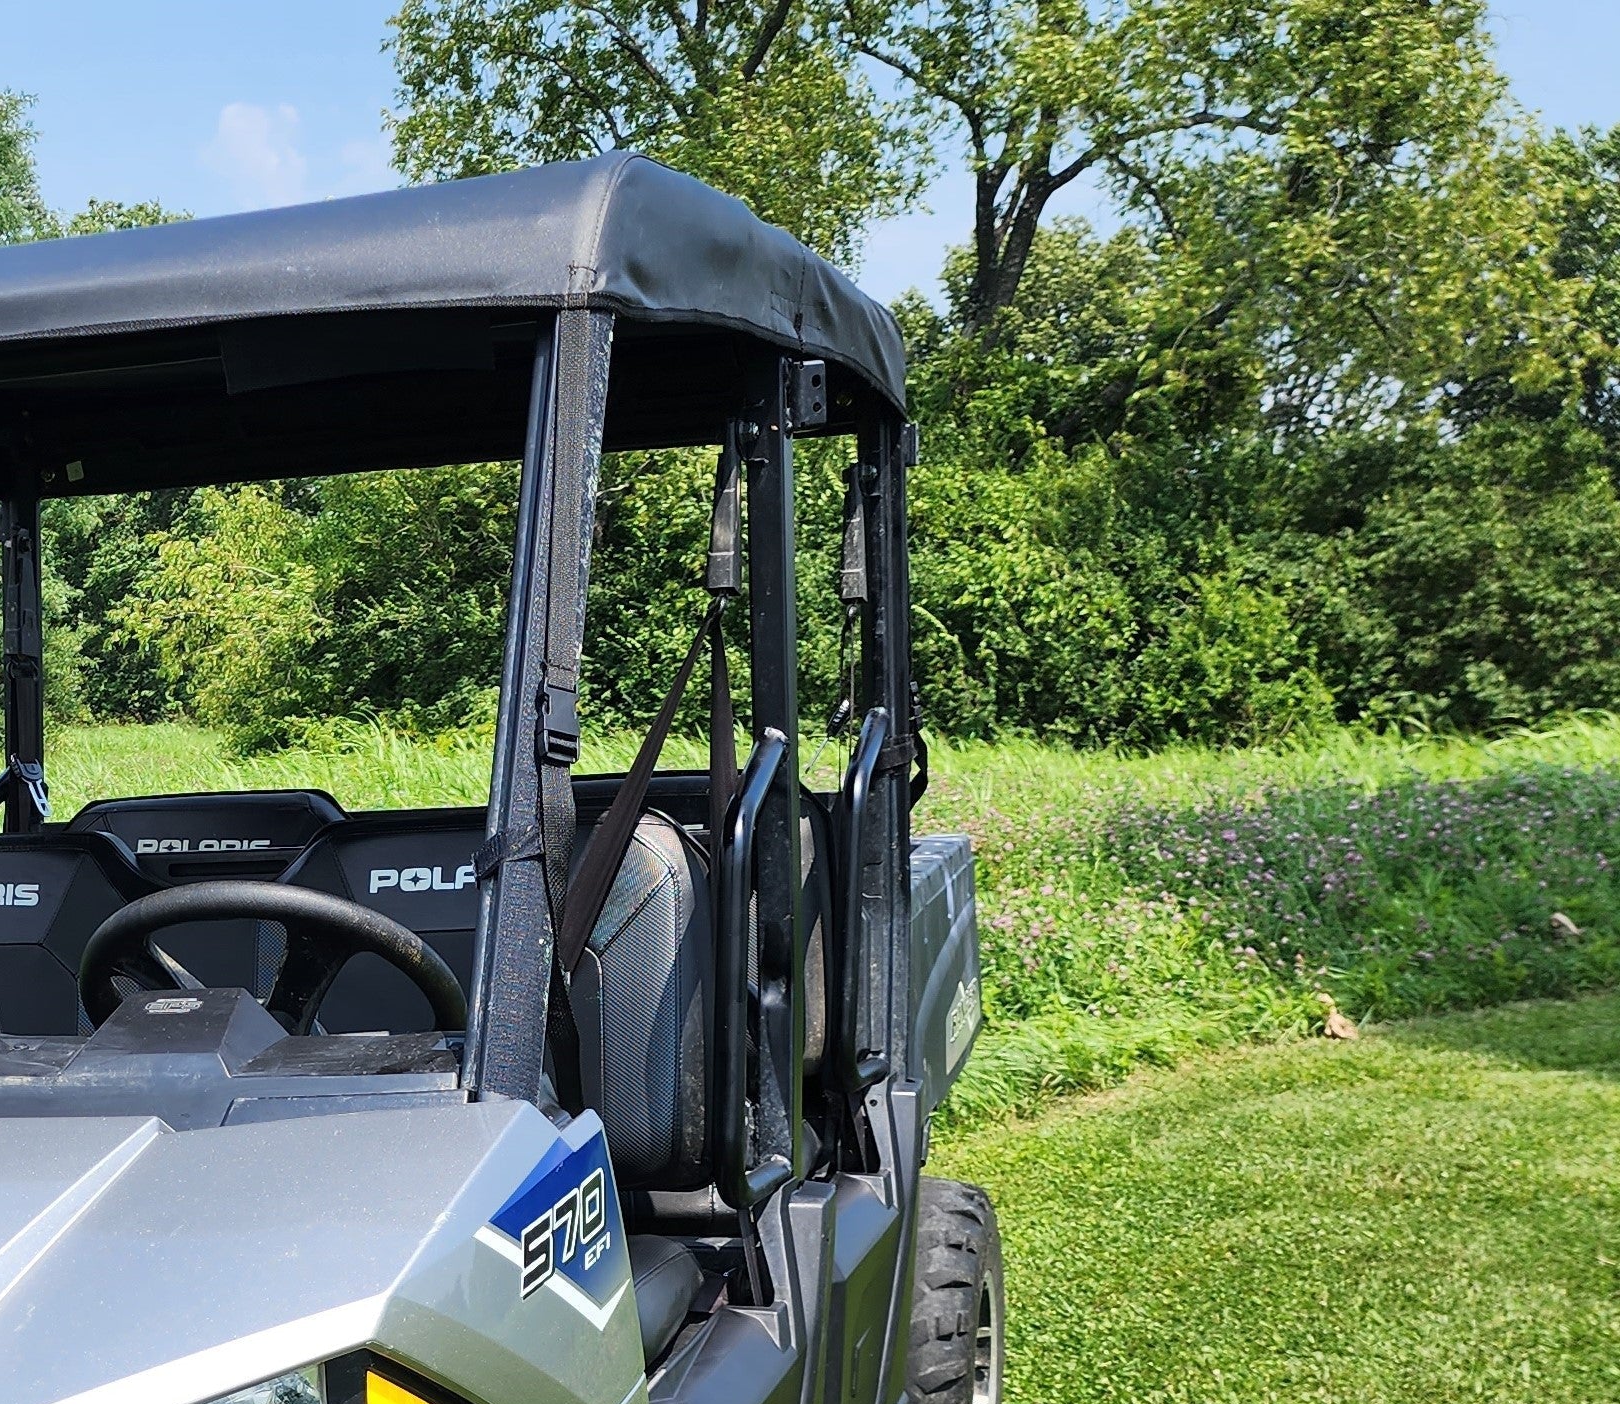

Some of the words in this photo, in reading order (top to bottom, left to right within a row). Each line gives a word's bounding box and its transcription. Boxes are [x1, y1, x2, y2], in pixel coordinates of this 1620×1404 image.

[368, 865, 476, 894] POLA
[520, 1167, 606, 1300] 570
[584, 1231, 611, 1271] EFI
